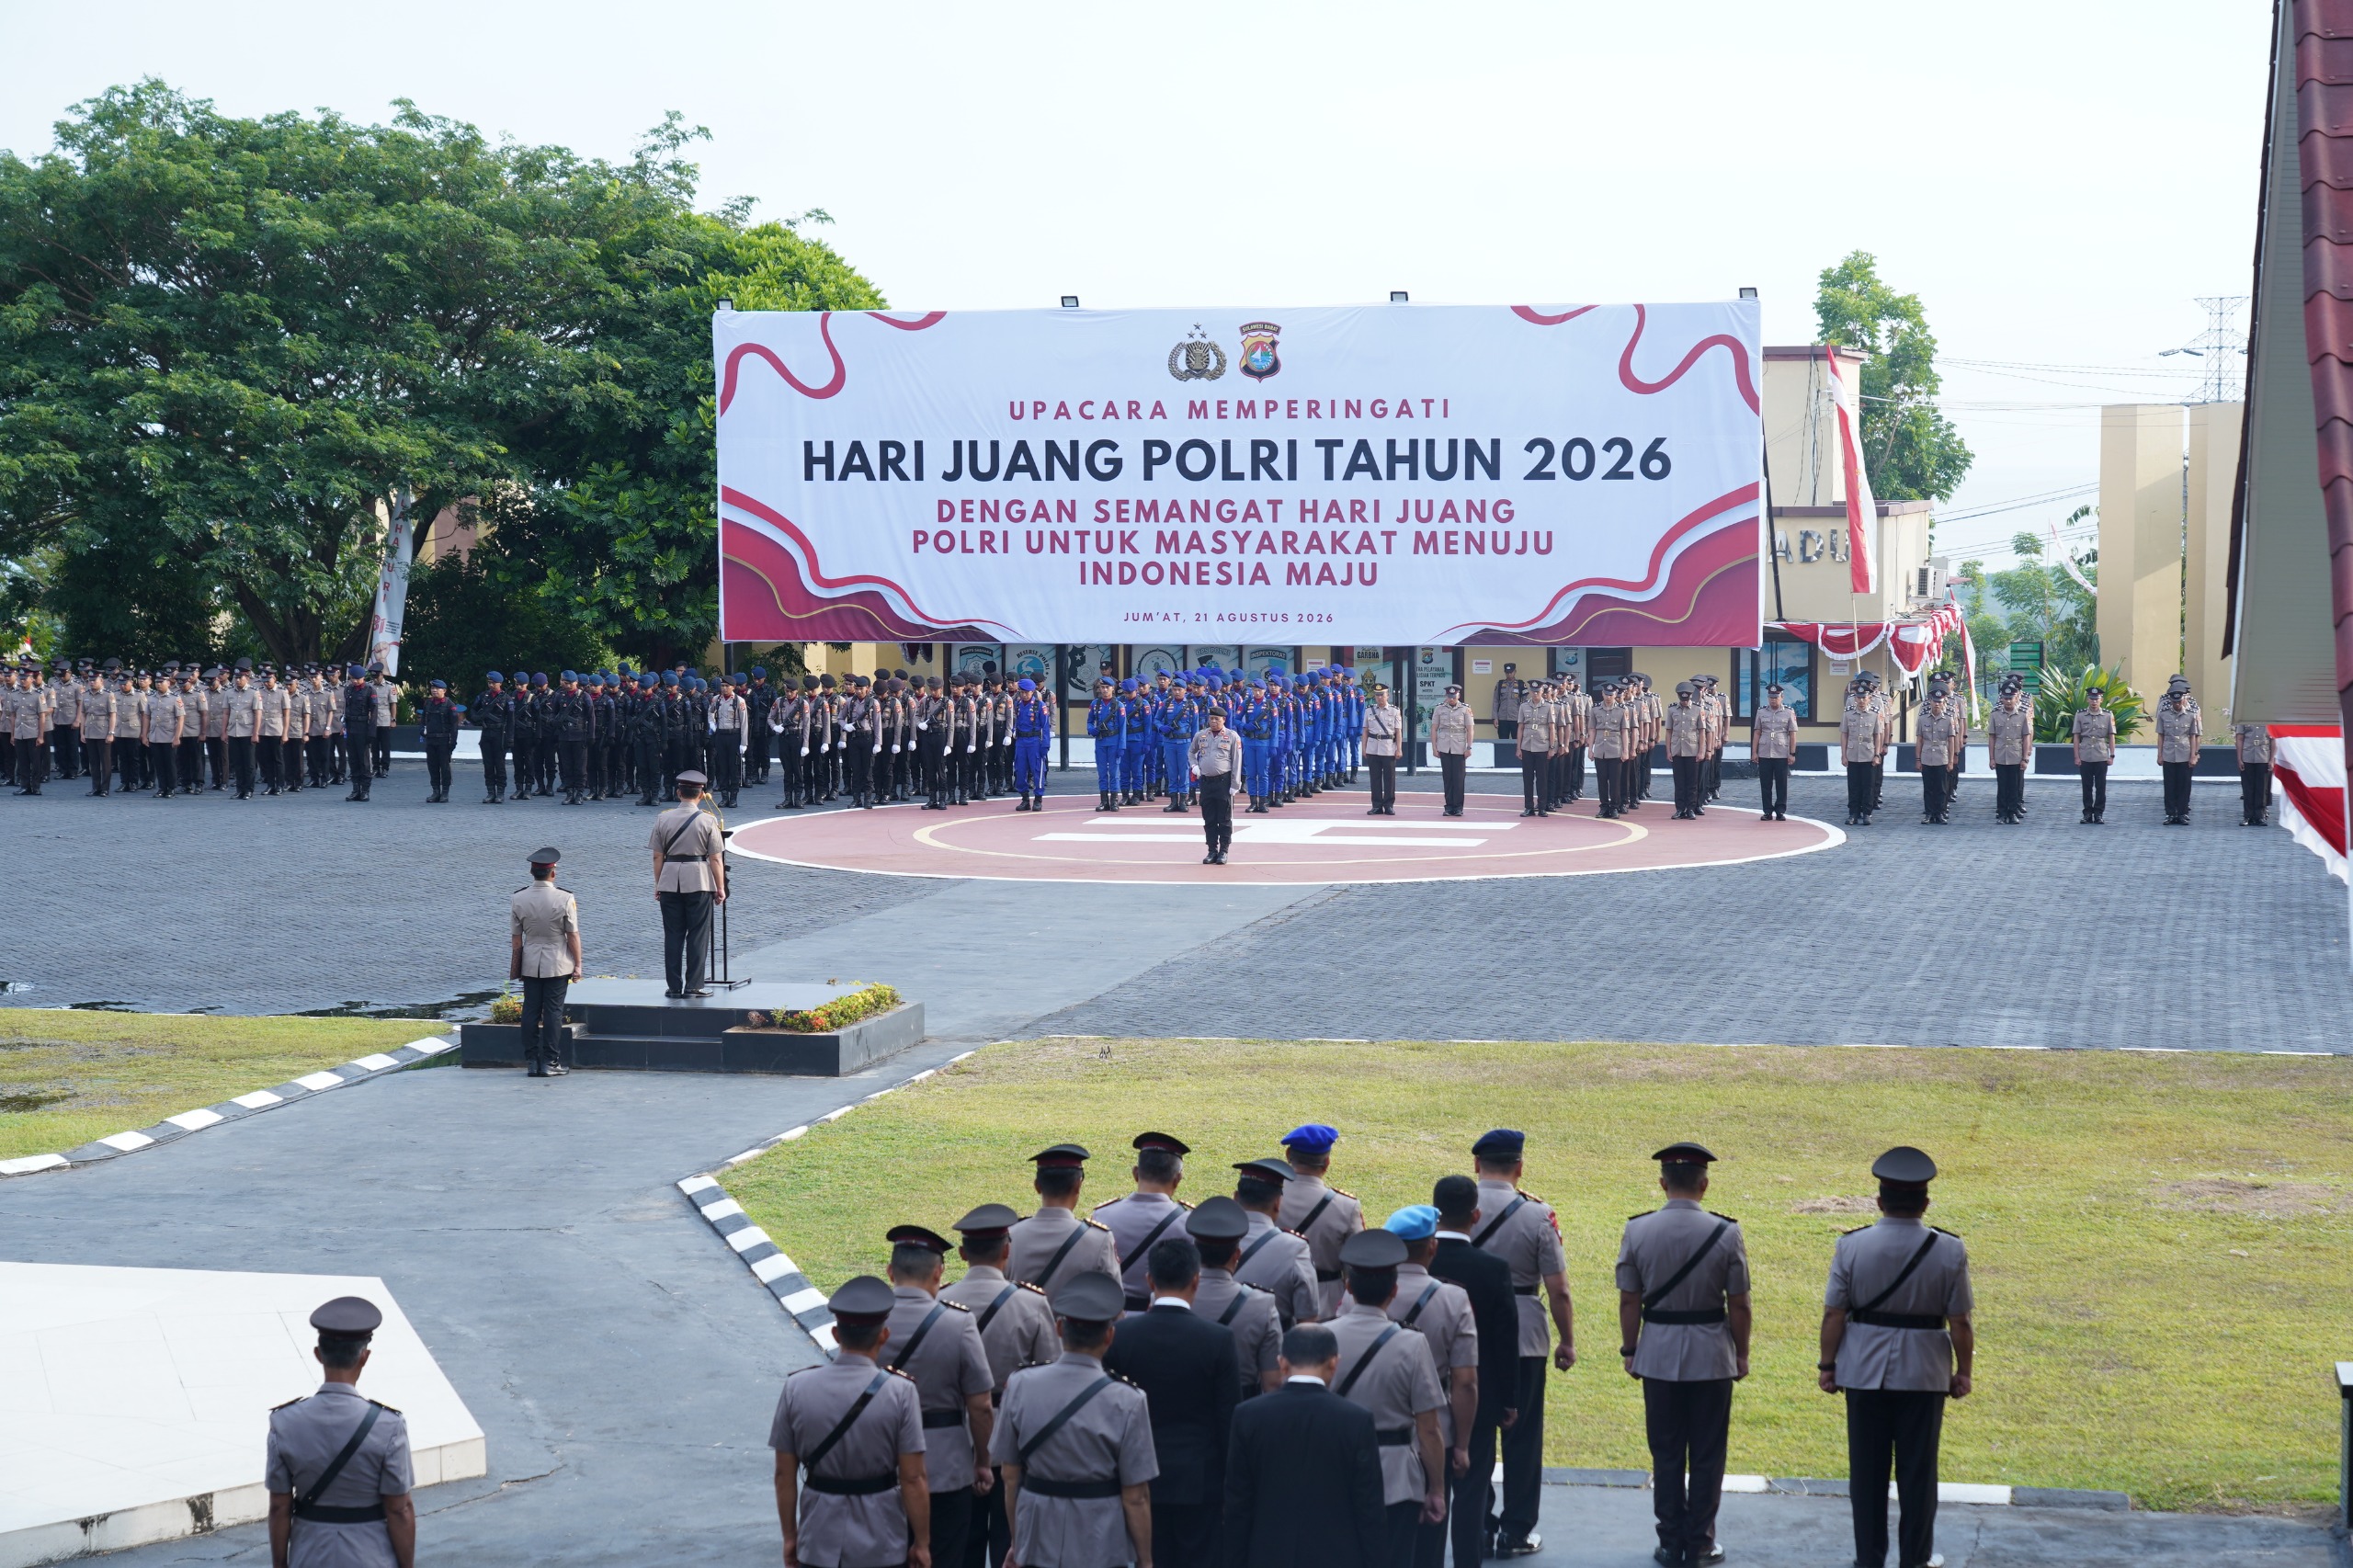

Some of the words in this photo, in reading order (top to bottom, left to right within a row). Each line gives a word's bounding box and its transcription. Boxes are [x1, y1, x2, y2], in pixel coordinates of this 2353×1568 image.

[1242, 324, 1264, 332] SULAWESI
[1264, 324, 1279, 332] BARAT
[1009, 400, 1168, 421] UPACARA
[1188, 398, 1449, 420] MEMPERINGATI
[803, 439, 925, 482] HARI
[940, 438, 1123, 483] JUANG
[1142, 437, 1298, 483] POLRI
[1314, 437, 1501, 482] TAHUN
[1522, 437, 1672, 481] 2026
[937, 499, 1077, 524] DENGAN
[1093, 498, 1284, 524] SEMANGAT
[1299, 498, 1381, 524] HARI
[1395, 498, 1515, 524] JUANG
[913, 529, 1009, 554] POLRI
[1025, 529, 1141, 555] UNTUK
[1154, 529, 1398, 555] MASYARAKAT
[1413, 530, 1553, 556] MENUJU
[1768, 528, 1850, 563] ADU
[1079, 561, 1271, 586] INDONESIA
[1286, 562, 1378, 587] MAJU
[1194, 611, 1208, 623] 21
[1216, 612, 1289, 623] AGUSTUS
[1297, 612, 1333, 623] 2026
[1016, 649, 1038, 659] RESERSE
[1038, 653, 1051, 670] POLRI
[1195, 647, 1208, 656] OPS
[1210, 646, 1232, 656] POLRI
[1250, 649, 1287, 659] INSPEKTORAT
[1357, 651, 1380, 659] GARBHA
